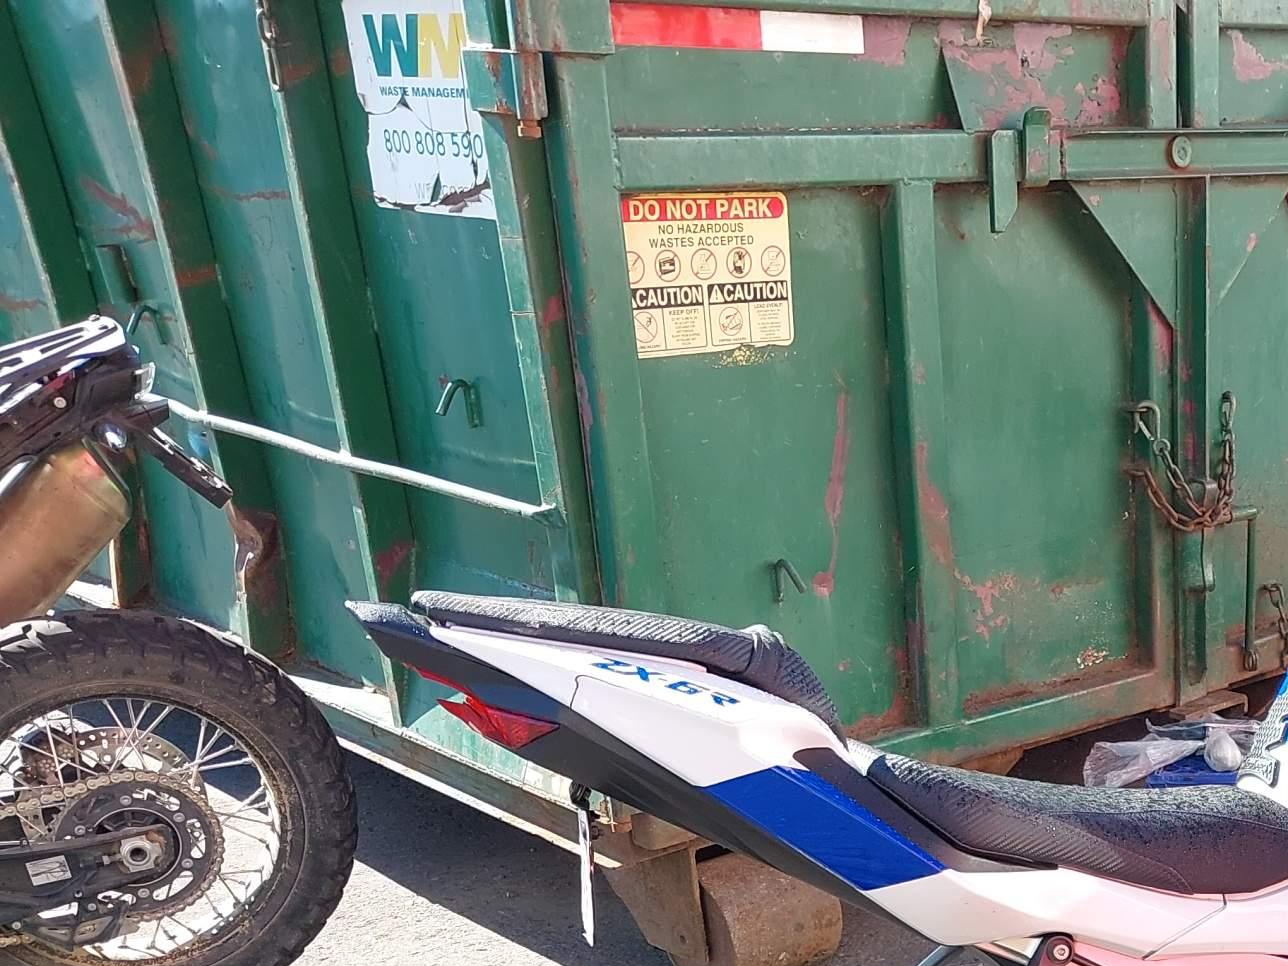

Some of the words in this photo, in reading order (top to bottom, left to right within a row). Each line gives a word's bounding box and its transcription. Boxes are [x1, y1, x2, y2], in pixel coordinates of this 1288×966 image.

[379, 86, 410, 97] WASTE
[384, 129, 411, 154] 800
[415, 131, 446, 156] 808
[629, 200, 661, 221] DO
[665, 199, 711, 220] NOT
[716, 197, 773, 219] PARK
[658, 224, 674, 235] NO
[677, 223, 744, 234] HAZARDOUS
[649, 237, 694, 249] WASTES
[697, 235, 754, 247] ACCEPTED
[635, 286, 703, 309] CAUTION
[723, 281, 788, 302] CAUTION
